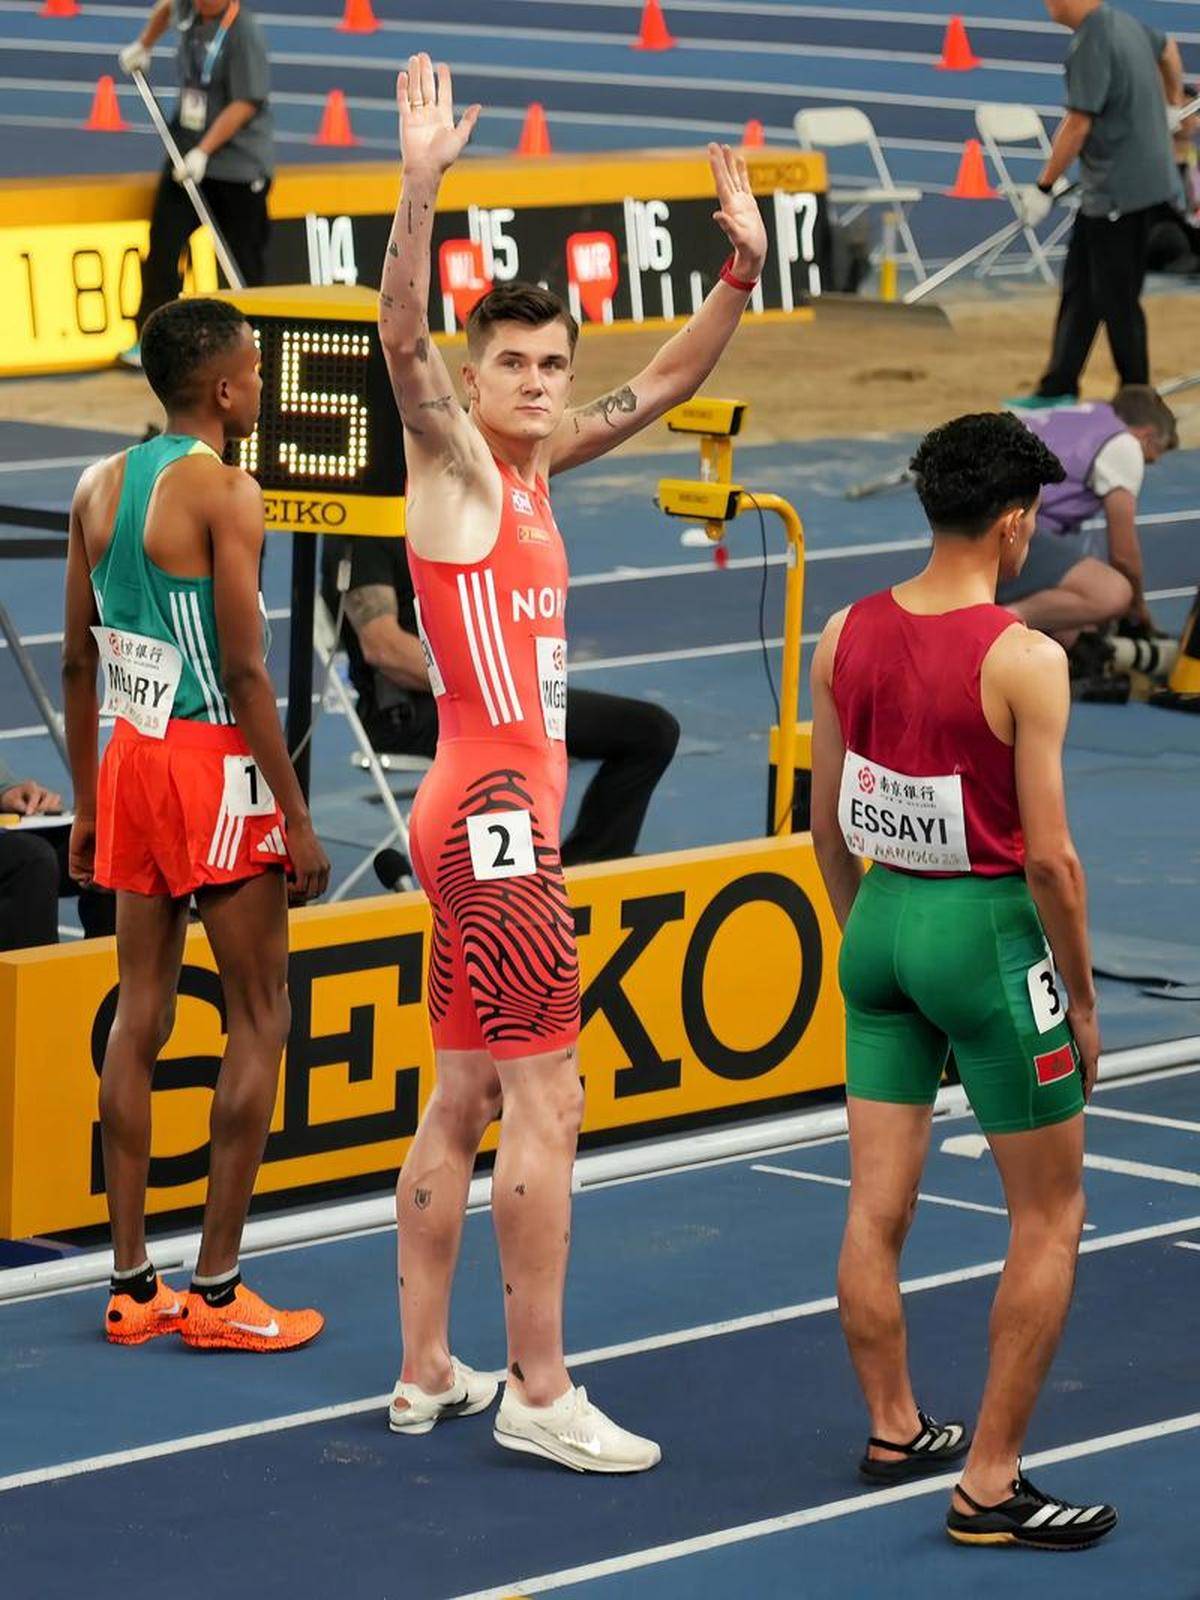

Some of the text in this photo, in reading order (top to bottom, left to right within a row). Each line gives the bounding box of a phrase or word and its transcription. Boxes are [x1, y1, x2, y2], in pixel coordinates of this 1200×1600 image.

[264, 498, 347, 527] EIKO
[244, 764, 258, 805] 1
[850, 797, 949, 845] ESSAYI
[487, 824, 516, 868] 2
[1039, 970, 1060, 1016] 3
[90, 871, 823, 1196] SEKO
